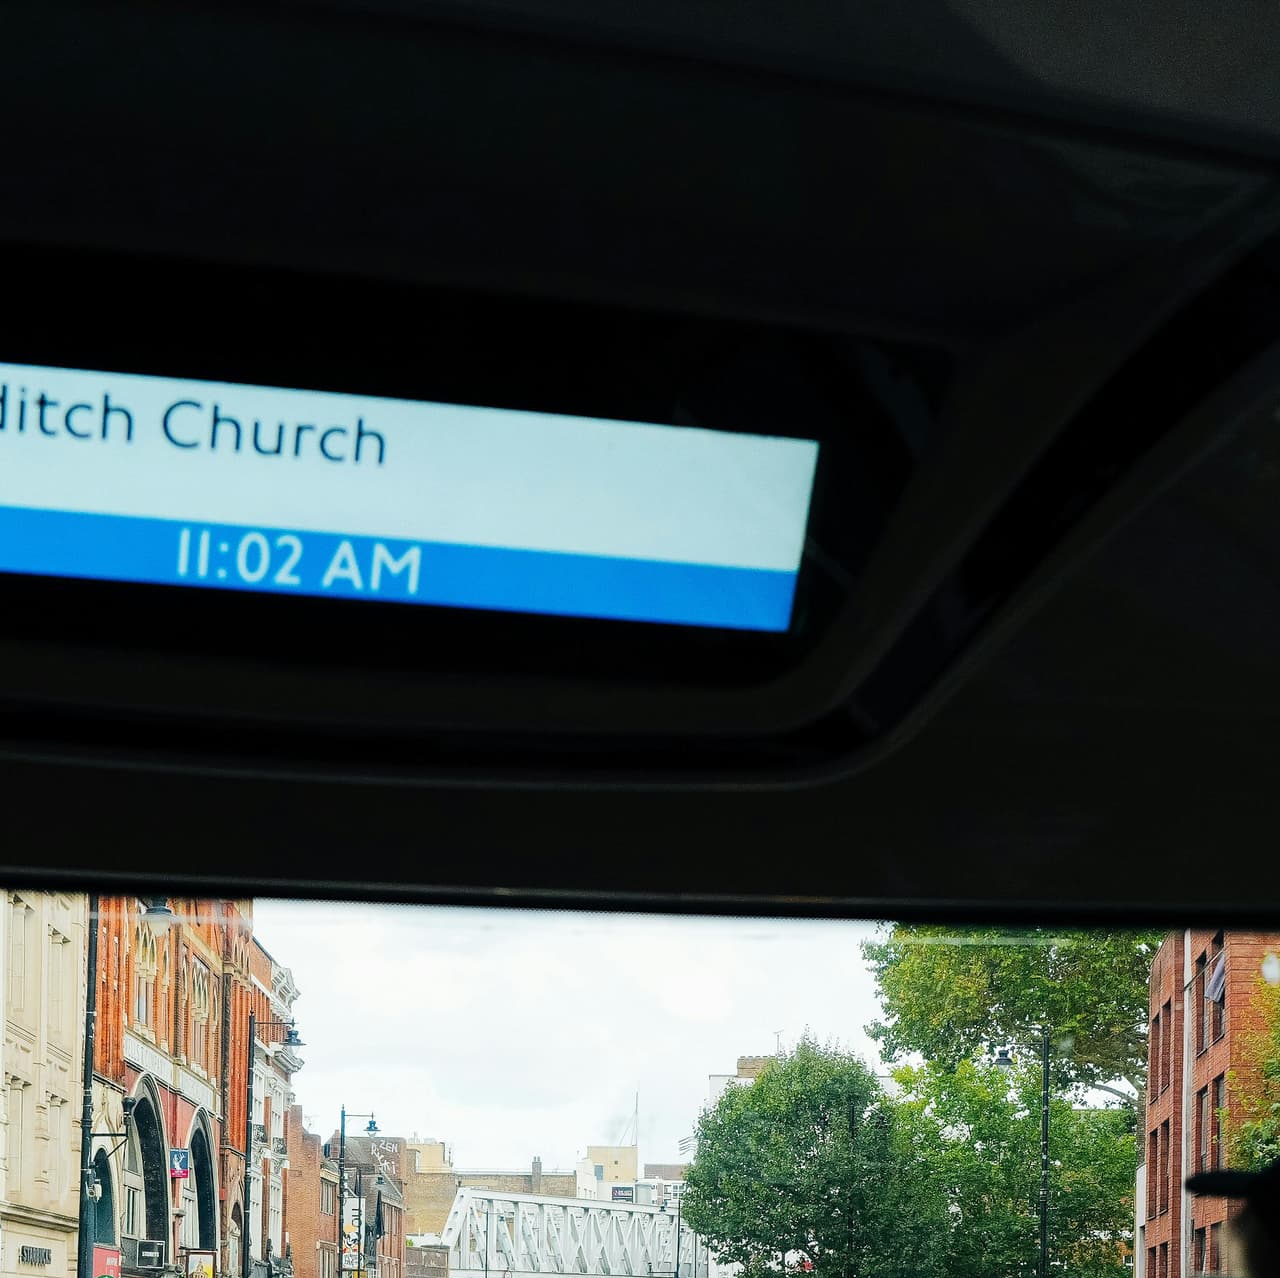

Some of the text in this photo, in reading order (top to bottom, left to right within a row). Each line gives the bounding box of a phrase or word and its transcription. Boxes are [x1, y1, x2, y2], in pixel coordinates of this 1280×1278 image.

[161, 399, 389, 466] Church
[176, 528, 424, 595] 11:02 AM
